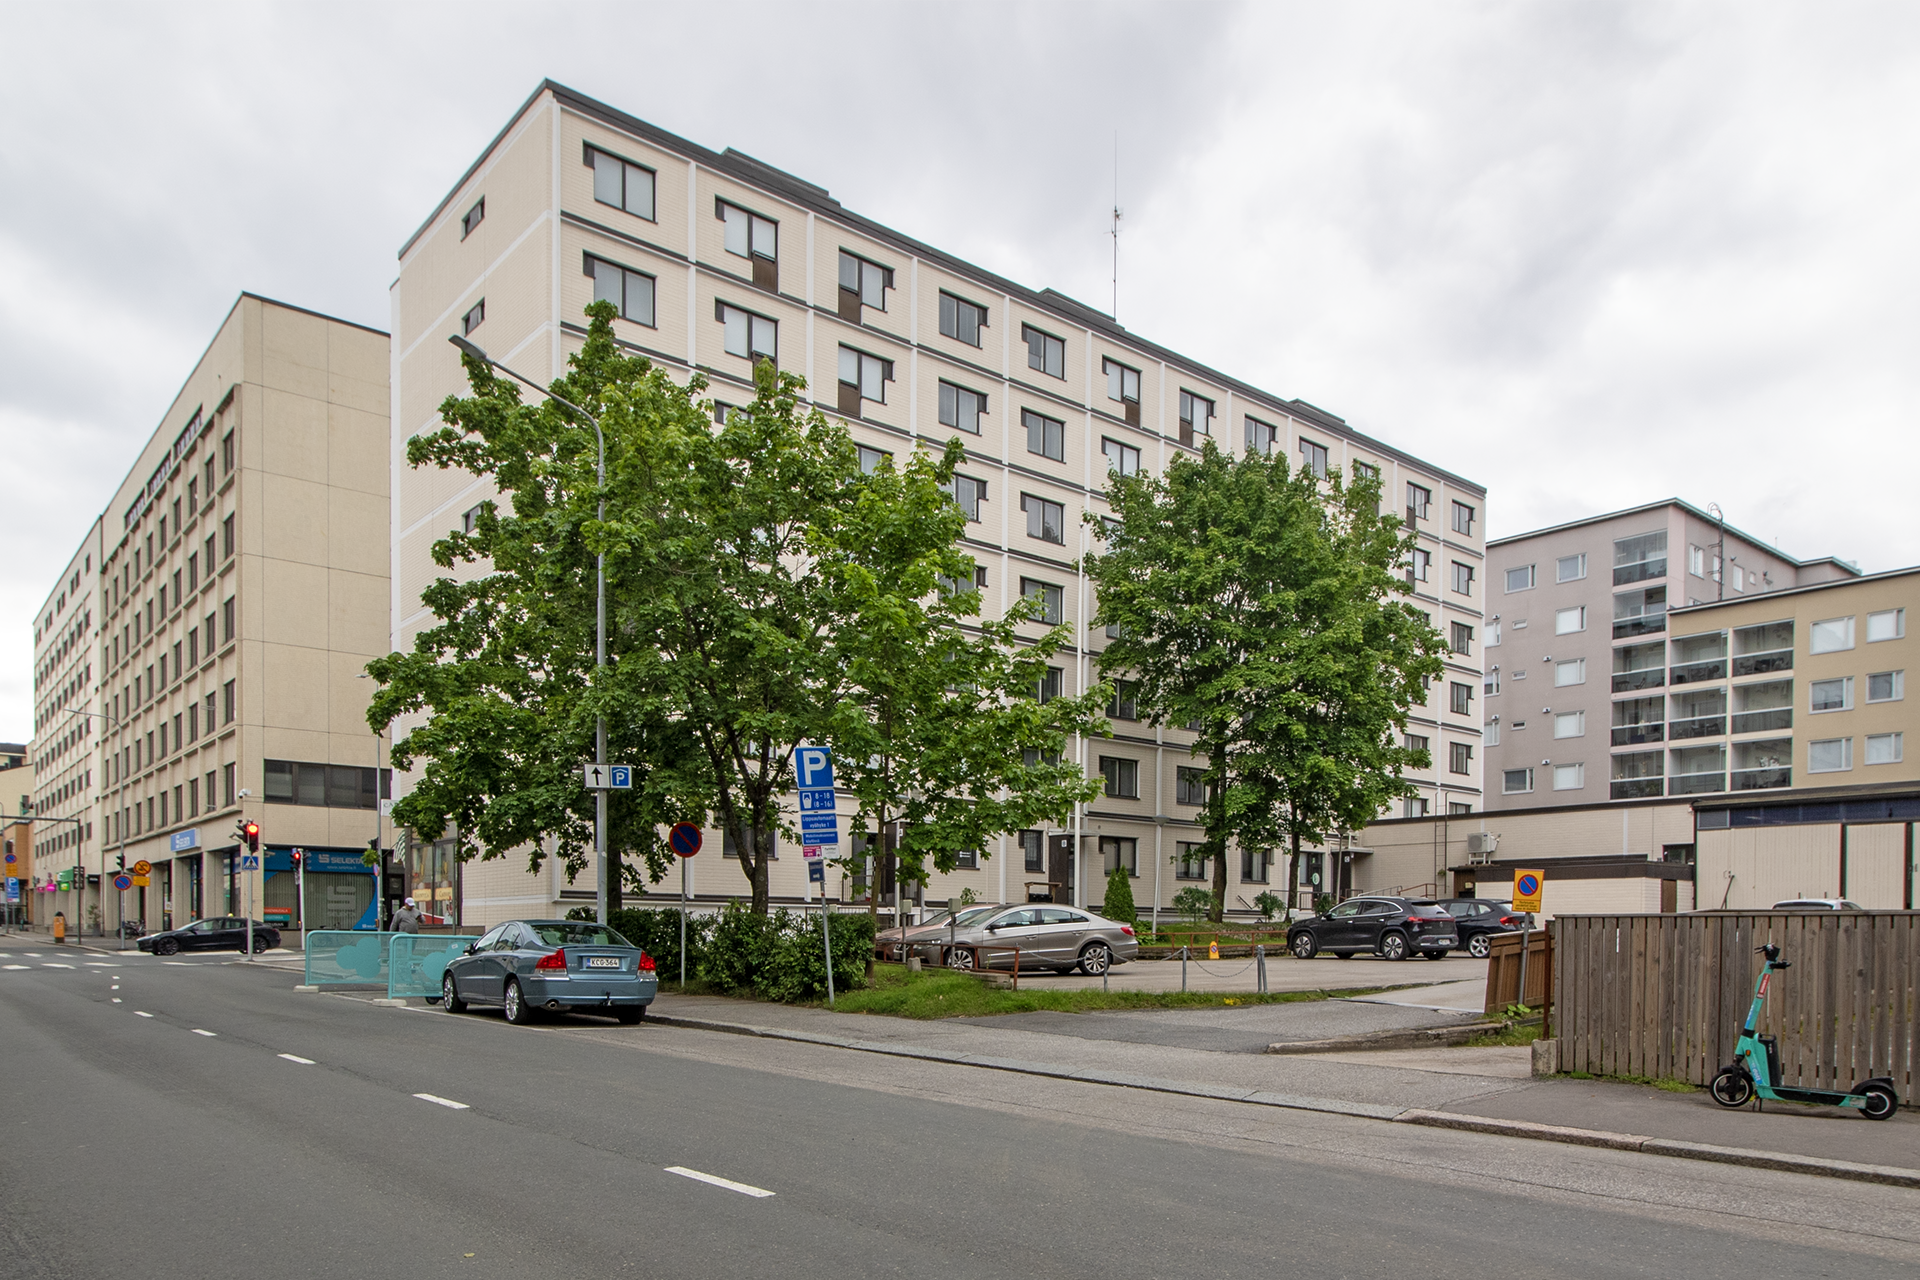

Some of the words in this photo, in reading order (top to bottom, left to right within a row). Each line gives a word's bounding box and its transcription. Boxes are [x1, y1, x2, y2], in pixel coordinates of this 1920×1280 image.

[803, 750, 827, 785] P
[616, 773, 625, 785] P
[8, 877, 17, 886] P
